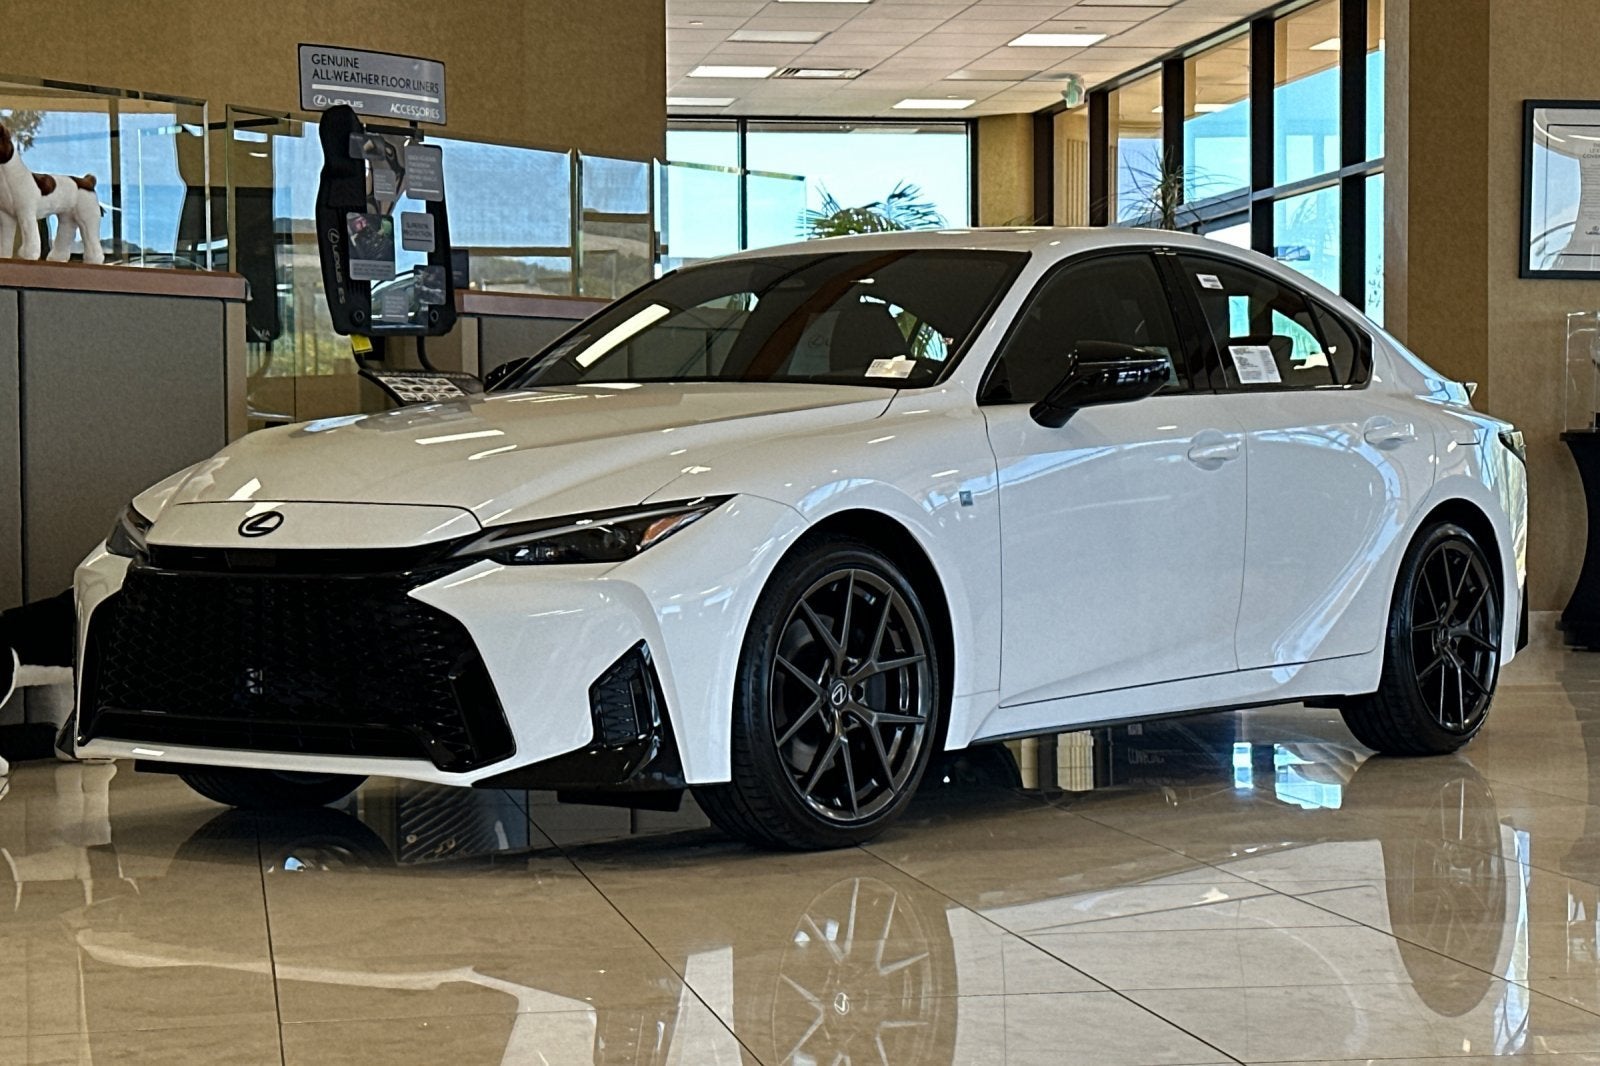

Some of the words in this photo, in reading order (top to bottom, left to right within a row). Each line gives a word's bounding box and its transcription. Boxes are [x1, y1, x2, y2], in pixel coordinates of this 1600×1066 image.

[311, 53, 360, 69] GENUINE
[312, 68, 380, 86] ALL-WEATHER
[381, 75, 411, 89] FLOOR
[412, 80, 439, 94] LINERS
[390, 102, 440, 119] ACCESSORIES
